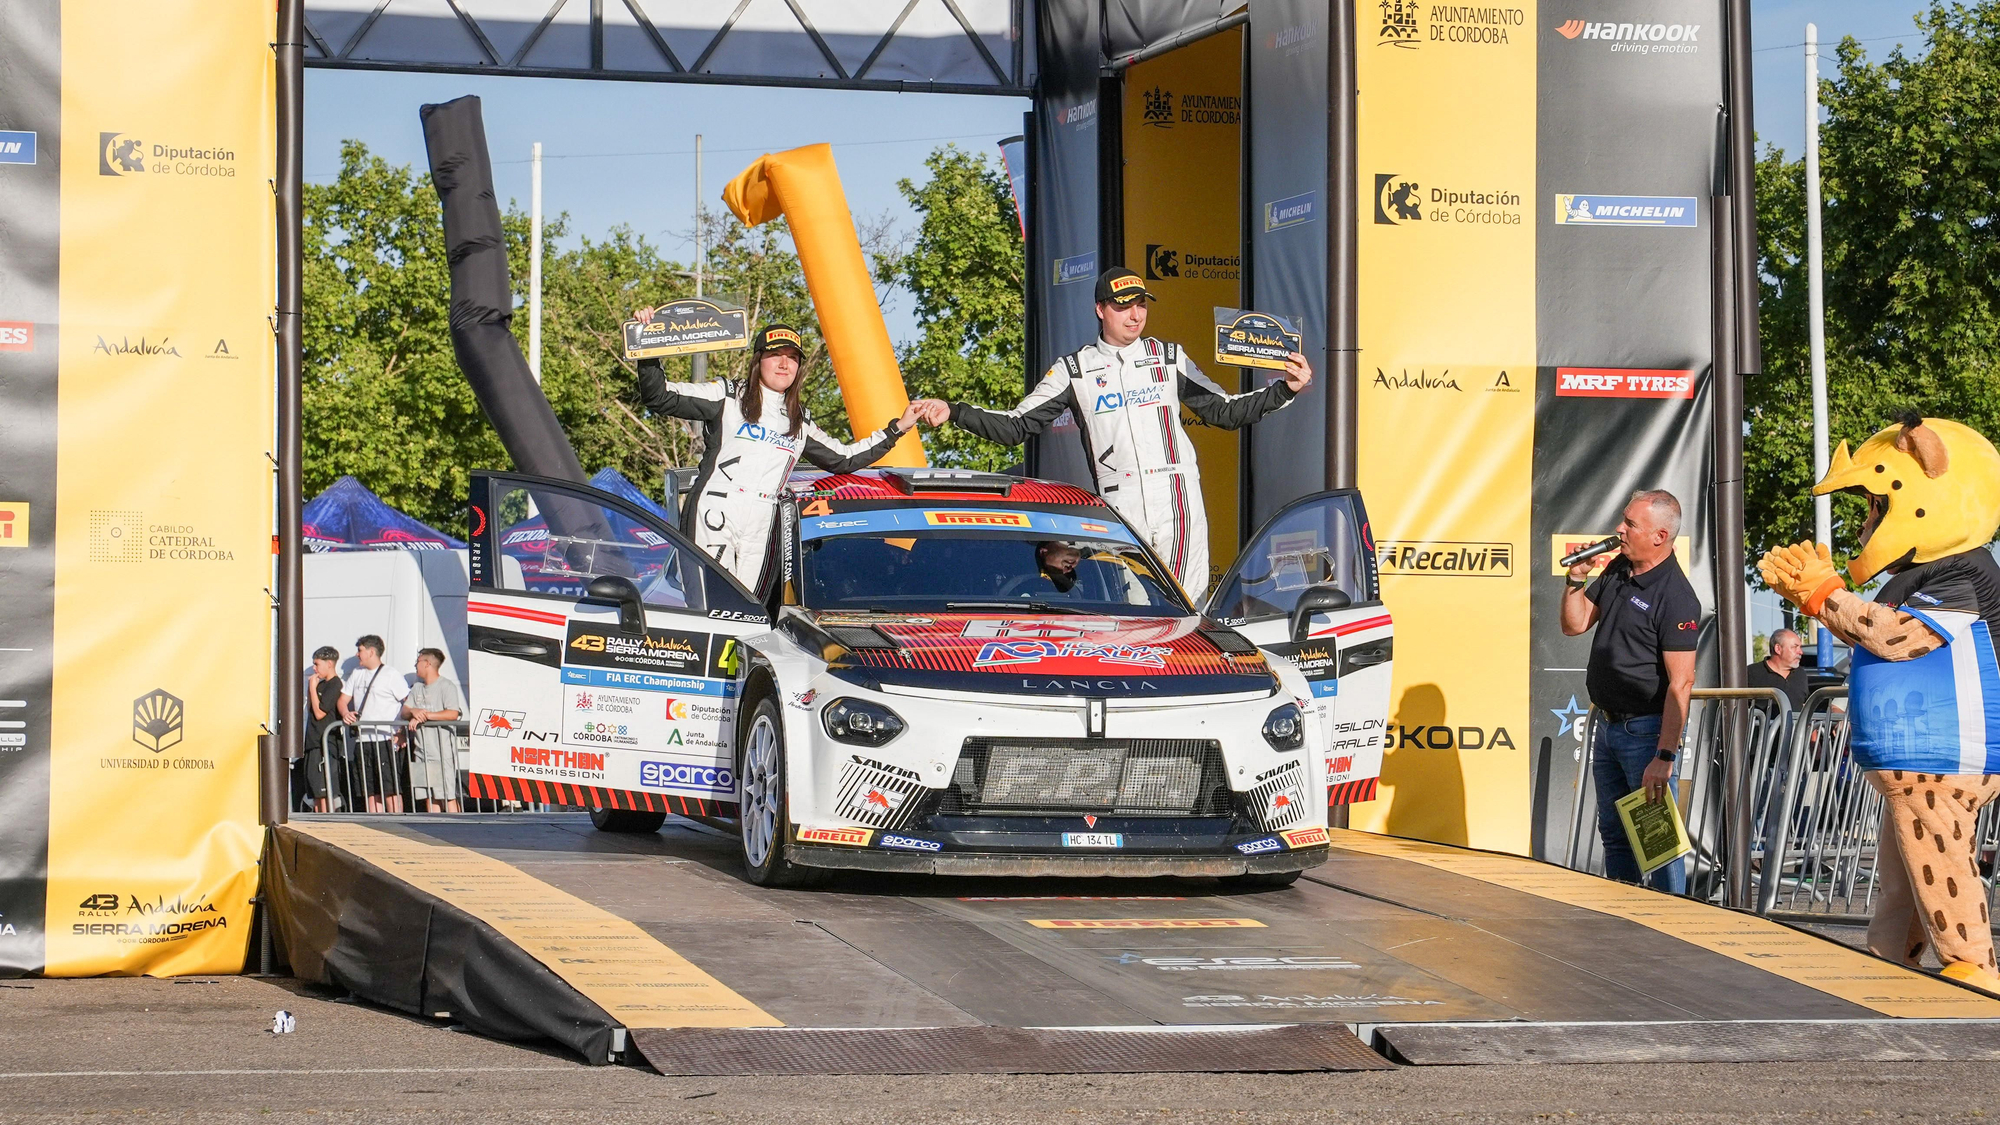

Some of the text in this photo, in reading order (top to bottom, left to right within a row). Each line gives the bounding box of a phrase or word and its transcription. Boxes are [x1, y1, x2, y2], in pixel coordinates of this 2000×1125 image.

[1430, 5, 1524, 25] AYUNTAMIENTO
[1430, 25, 1445, 41] DE
[1611, 42, 1698, 55] driving emotion
[1181, 95, 1240, 109] AYUNTAMIEN
[1181, 110, 1192, 122] DE
[152, 144, 235, 161] Diputación
[152, 161, 235, 177] de Córdoba
[1431, 188, 1520, 207] Diputación
[1280, 202, 1311, 219] MICHELIN
[1430, 208, 1521, 225] de Córdoba
[1596, 205, 1684, 218] MICHELIN
[1069, 261, 1094, 275] MICHELIN
[1185, 254, 1240, 269] Diputació
[1185, 267, 1240, 280] de Córdob
[640, 330, 731, 345] SIERRA MORENA
[1230, 330, 1246, 340] 43
[1227, 344, 1290, 357] SIERRA MORENA
[1560, 374, 1689, 391] MRF TYRES
[1095, 386, 1157, 411] ACI TEAM
[1125, 393, 1161, 406] ITALIA
[737, 423, 766, 441] ACI
[765, 436, 796, 450] ITALIA
[802, 500, 834, 516] 4
[935, 512, 1021, 526] PIRELLI
[149, 525, 193, 534] CABILDO
[149, 536, 216, 548] CATEDRAL
[150, 547, 234, 561] DE CÓRDOBA
[1399, 547, 1488, 571] Recalvi
[570, 634, 605, 652] 43
[606, 637, 643, 648] RALLY
[606, 644, 700, 661] SIERRA MORENA
[1059, 648, 1166, 664] ITALIA
[635, 656, 665, 666] CÓRDOBA
[606, 673, 705, 690] FIA ERC Championship
[1023, 679, 1158, 690] LANCIA
[597, 694, 640, 705] AYUNTAMIENTO
[597, 703, 604, 711] DE
[692, 704, 731, 714] Diputación
[702, 713, 731, 722] Córdoba
[1334, 719, 1384, 733] PSILON
[573, 732, 612, 743] CÓRDOBA
[695, 739, 727, 748] Andalucía
[100, 758, 159, 769] UNIVERSIDAD
[173, 756, 215, 770] CÓRDOBA
[511, 746, 604, 771] NORTHON
[511, 765, 605, 779] TRASMISSIONI
[642, 763, 733, 787] sparco
[803, 828, 867, 843] PIRELLI
[882, 835, 941, 850] sparco
[1070, 835, 1082, 845] HC
[1104, 835, 1115, 845] TL
[1286, 828, 1327, 846] PIRELLI
[1238, 838, 1278, 852] sparco
[79, 894, 119, 910] 43
[72, 916, 226, 935] SIERRA MORENA
[1050, 919, 1242, 927] PIRELLI
